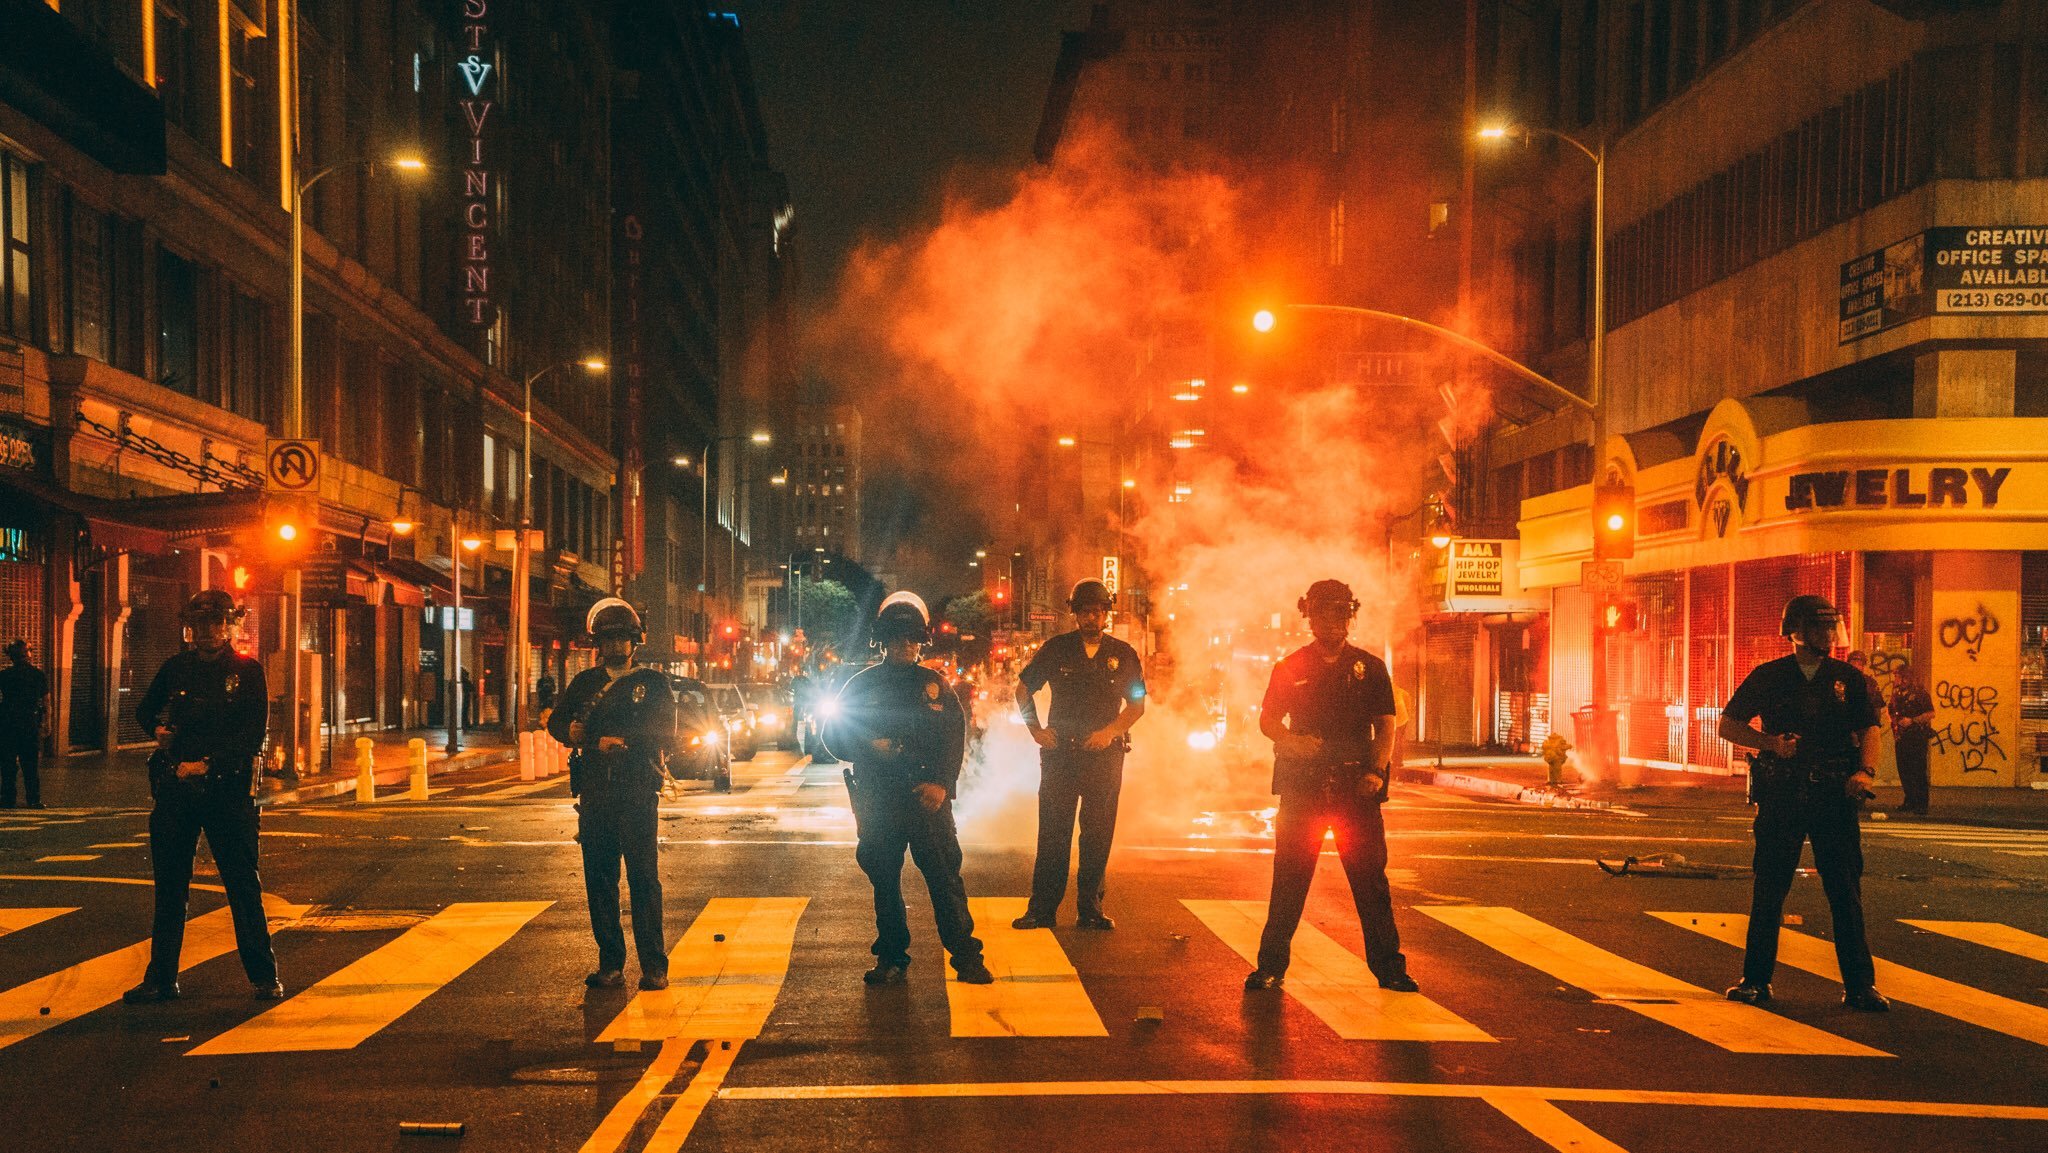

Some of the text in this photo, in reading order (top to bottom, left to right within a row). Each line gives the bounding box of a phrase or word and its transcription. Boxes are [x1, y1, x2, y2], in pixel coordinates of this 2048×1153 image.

[460, 102, 492, 323] VINCENT
[1966, 229, 2048, 246] CREATIV
[1936, 249, 2003, 266] OFFICE
[1946, 292, 1990, 308] (213)
[1785, 467, 2012, 510] JEWELRY
[1463, 543, 1494, 556] AAA
[1456, 560, 1500, 570] HIP HOP
[1458, 571, 1498, 579] JEWELRY
[1457, 584, 1500, 592] WHOLESALE
[1929, 721, 2007, 760] FUCK
[1960, 749, 1998, 774] 12
